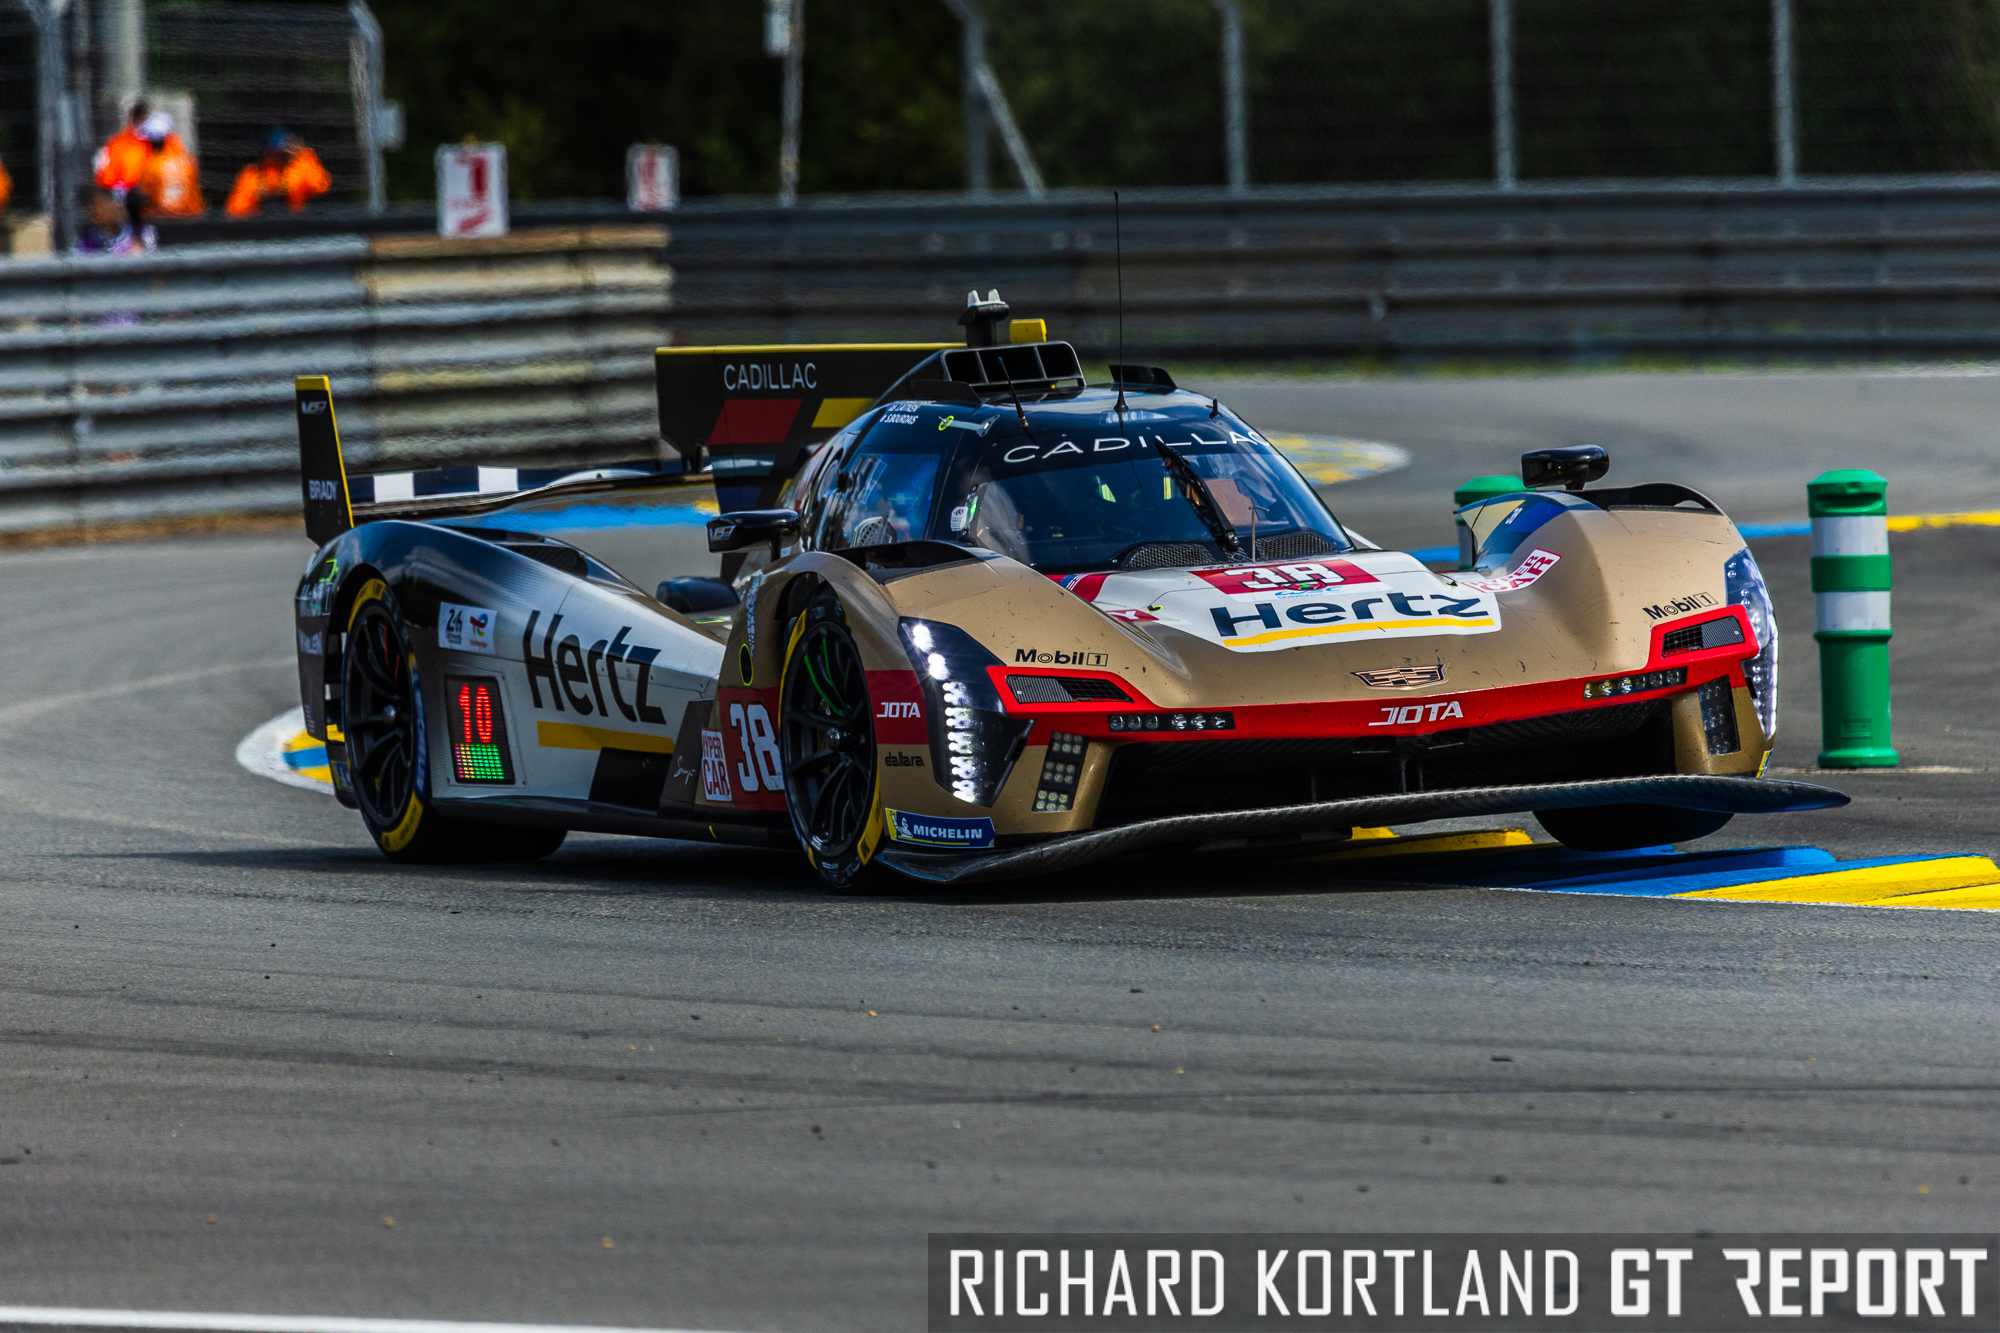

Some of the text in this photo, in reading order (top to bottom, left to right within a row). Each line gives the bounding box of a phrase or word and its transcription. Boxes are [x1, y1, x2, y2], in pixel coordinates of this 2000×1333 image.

[724, 362, 817, 390] CADILLAC
[1003, 430, 1270, 463] CADILLAC
[309, 479, 338, 500] BRADY
[1222, 563, 1347, 590] 38
[1480, 556, 1554, 590] CAR
[1210, 592, 1489, 637] Hertz
[1642, 596, 1702, 620] Mobil
[523, 610, 667, 725] Hertz
[1015, 648, 1085, 665] Mobil
[459, 683, 492, 743] 10
[877, 702, 921, 718] JOTA
[1368, 701, 1463, 726] JOTA
[730, 703, 785, 792] 38
[885, 752, 925, 767] dallara
[703, 759, 730, 796] CAR
[913, 824, 983, 839] MICHELIN
